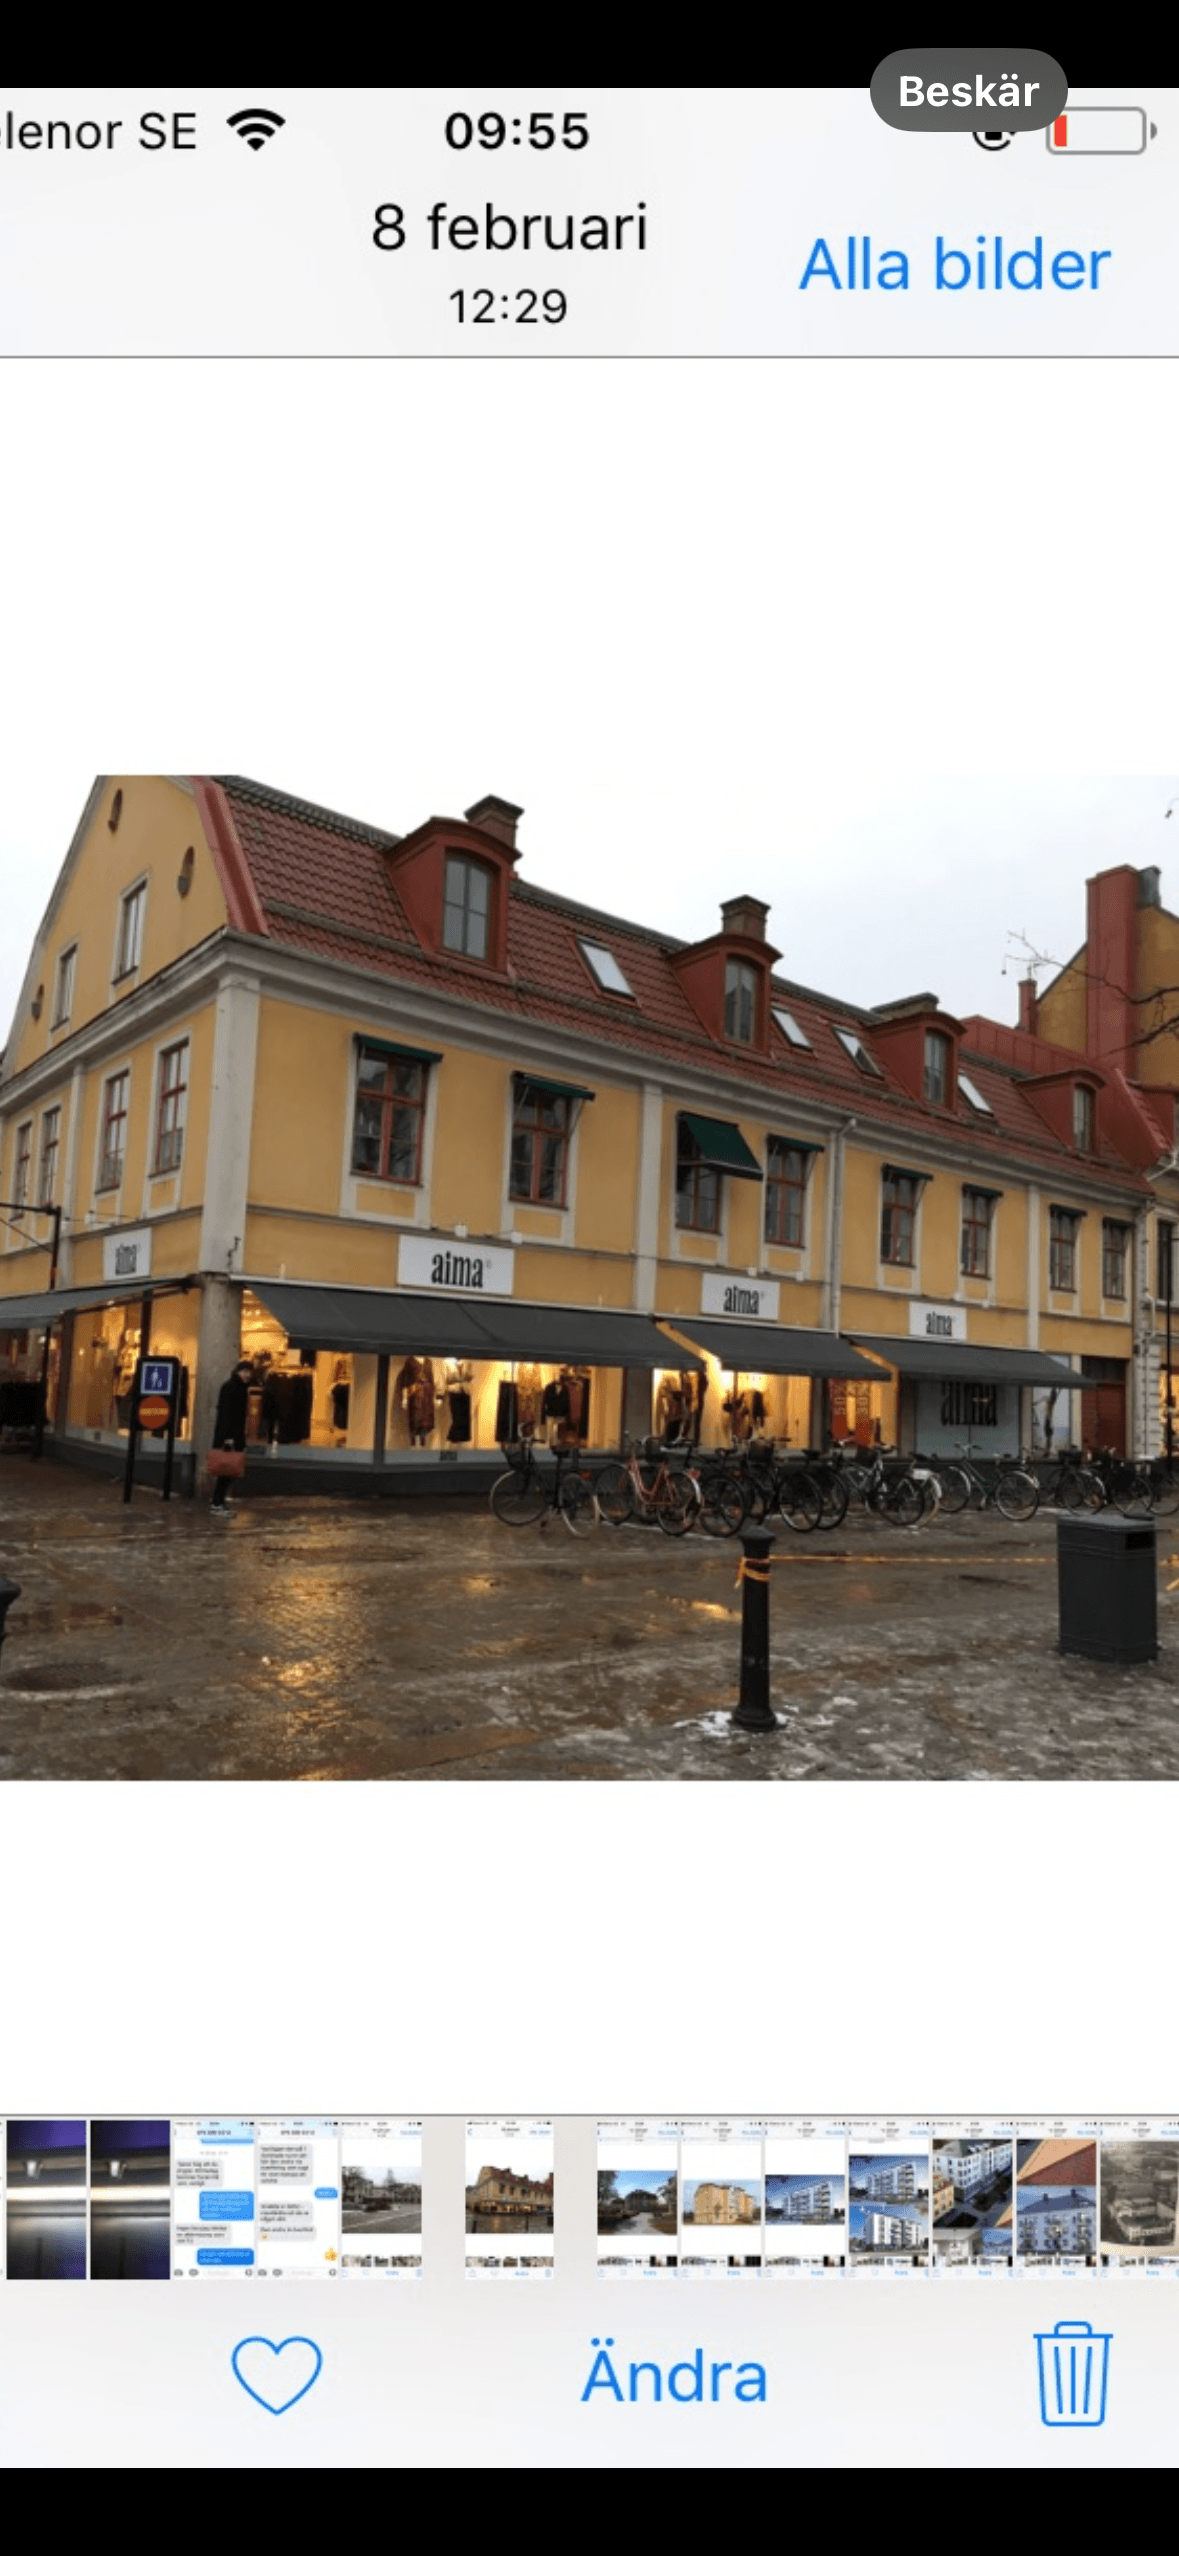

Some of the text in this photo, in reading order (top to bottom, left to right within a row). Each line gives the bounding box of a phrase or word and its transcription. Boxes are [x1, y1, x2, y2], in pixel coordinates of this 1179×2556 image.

[0, 110, 197, 150] lenor SE
[444, 111, 590, 151] 09:55
[372, 201, 648, 251] 8 februari
[798, 235, 1113, 291] Alla bilder
[449, 288, 568, 324] 12:29
[431, 1250, 483, 1289] aima
[723, 1284, 760, 1314] aima
[580, 2337, 768, 2403] Ändra
